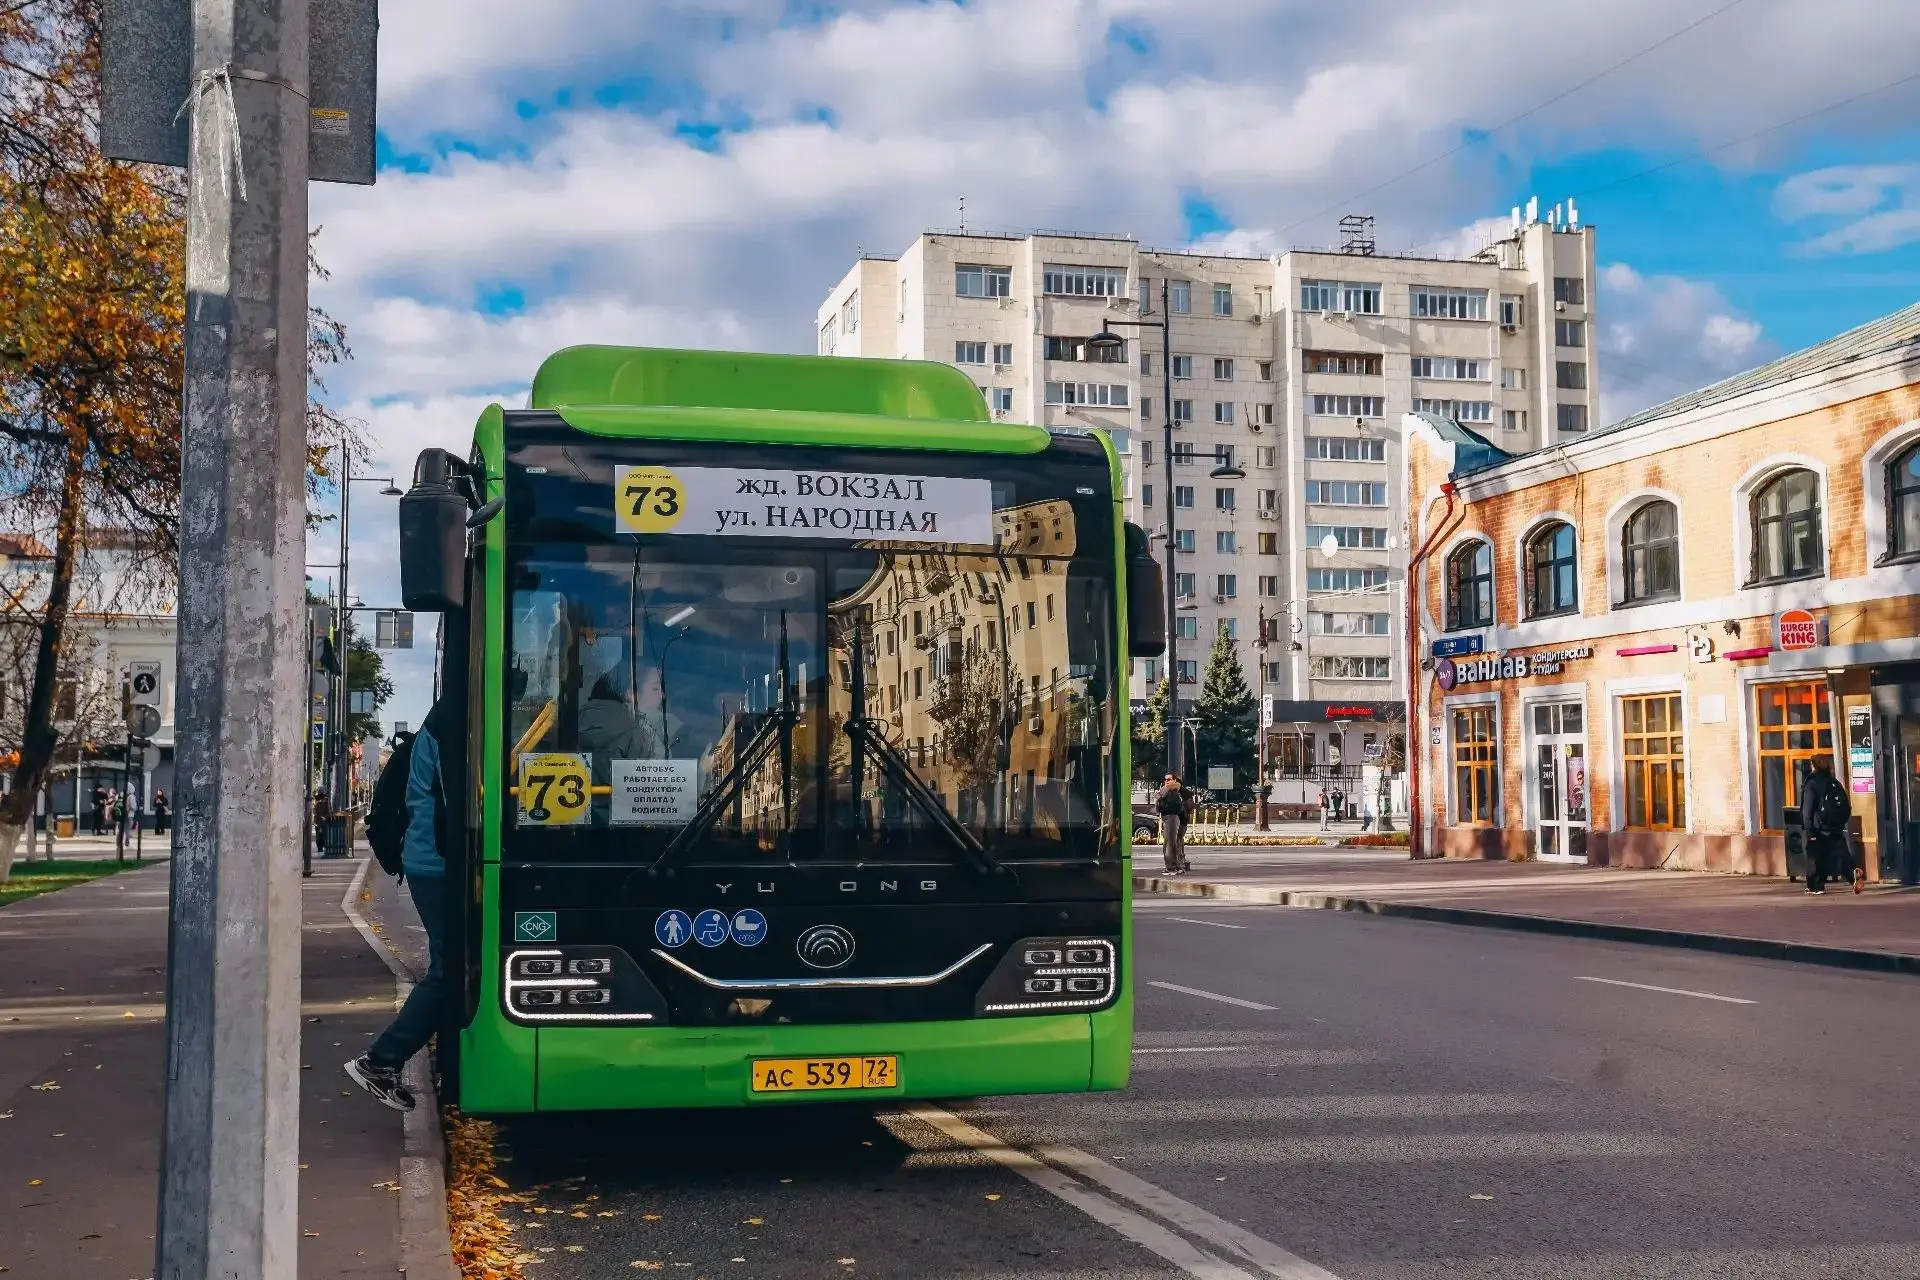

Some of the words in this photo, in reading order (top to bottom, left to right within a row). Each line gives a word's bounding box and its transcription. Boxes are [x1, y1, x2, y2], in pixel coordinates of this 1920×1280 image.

[736, 478, 787, 498] жд.
[796, 474, 926, 501] ВОКЗАЛ
[625, 485, 679, 517] 73
[715, 510, 757, 533] ул.
[765, 505, 938, 536] НАРОДНАЯ
[1780, 623, 1814, 632] BURGER
[1781, 631, 1816, 644] KING
[1531, 648, 1589, 663] КОНДИТЕРСКАЯ
[1530, 662, 1560, 675] СТУДИЯ
[635, 765, 675, 773] АВТОБУС
[527, 774, 586, 809] 73
[633, 796, 669, 804] ОПЛАТА
[670, 796, 676, 804] У
[631, 806, 678, 814] ВОДИТЕЛЯ
[524, 922, 546, 932] CNG
[806, 1061, 851, 1086] 539
[865, 1059, 888, 1078] 72
[868, 1077, 886, 1085] RUS
